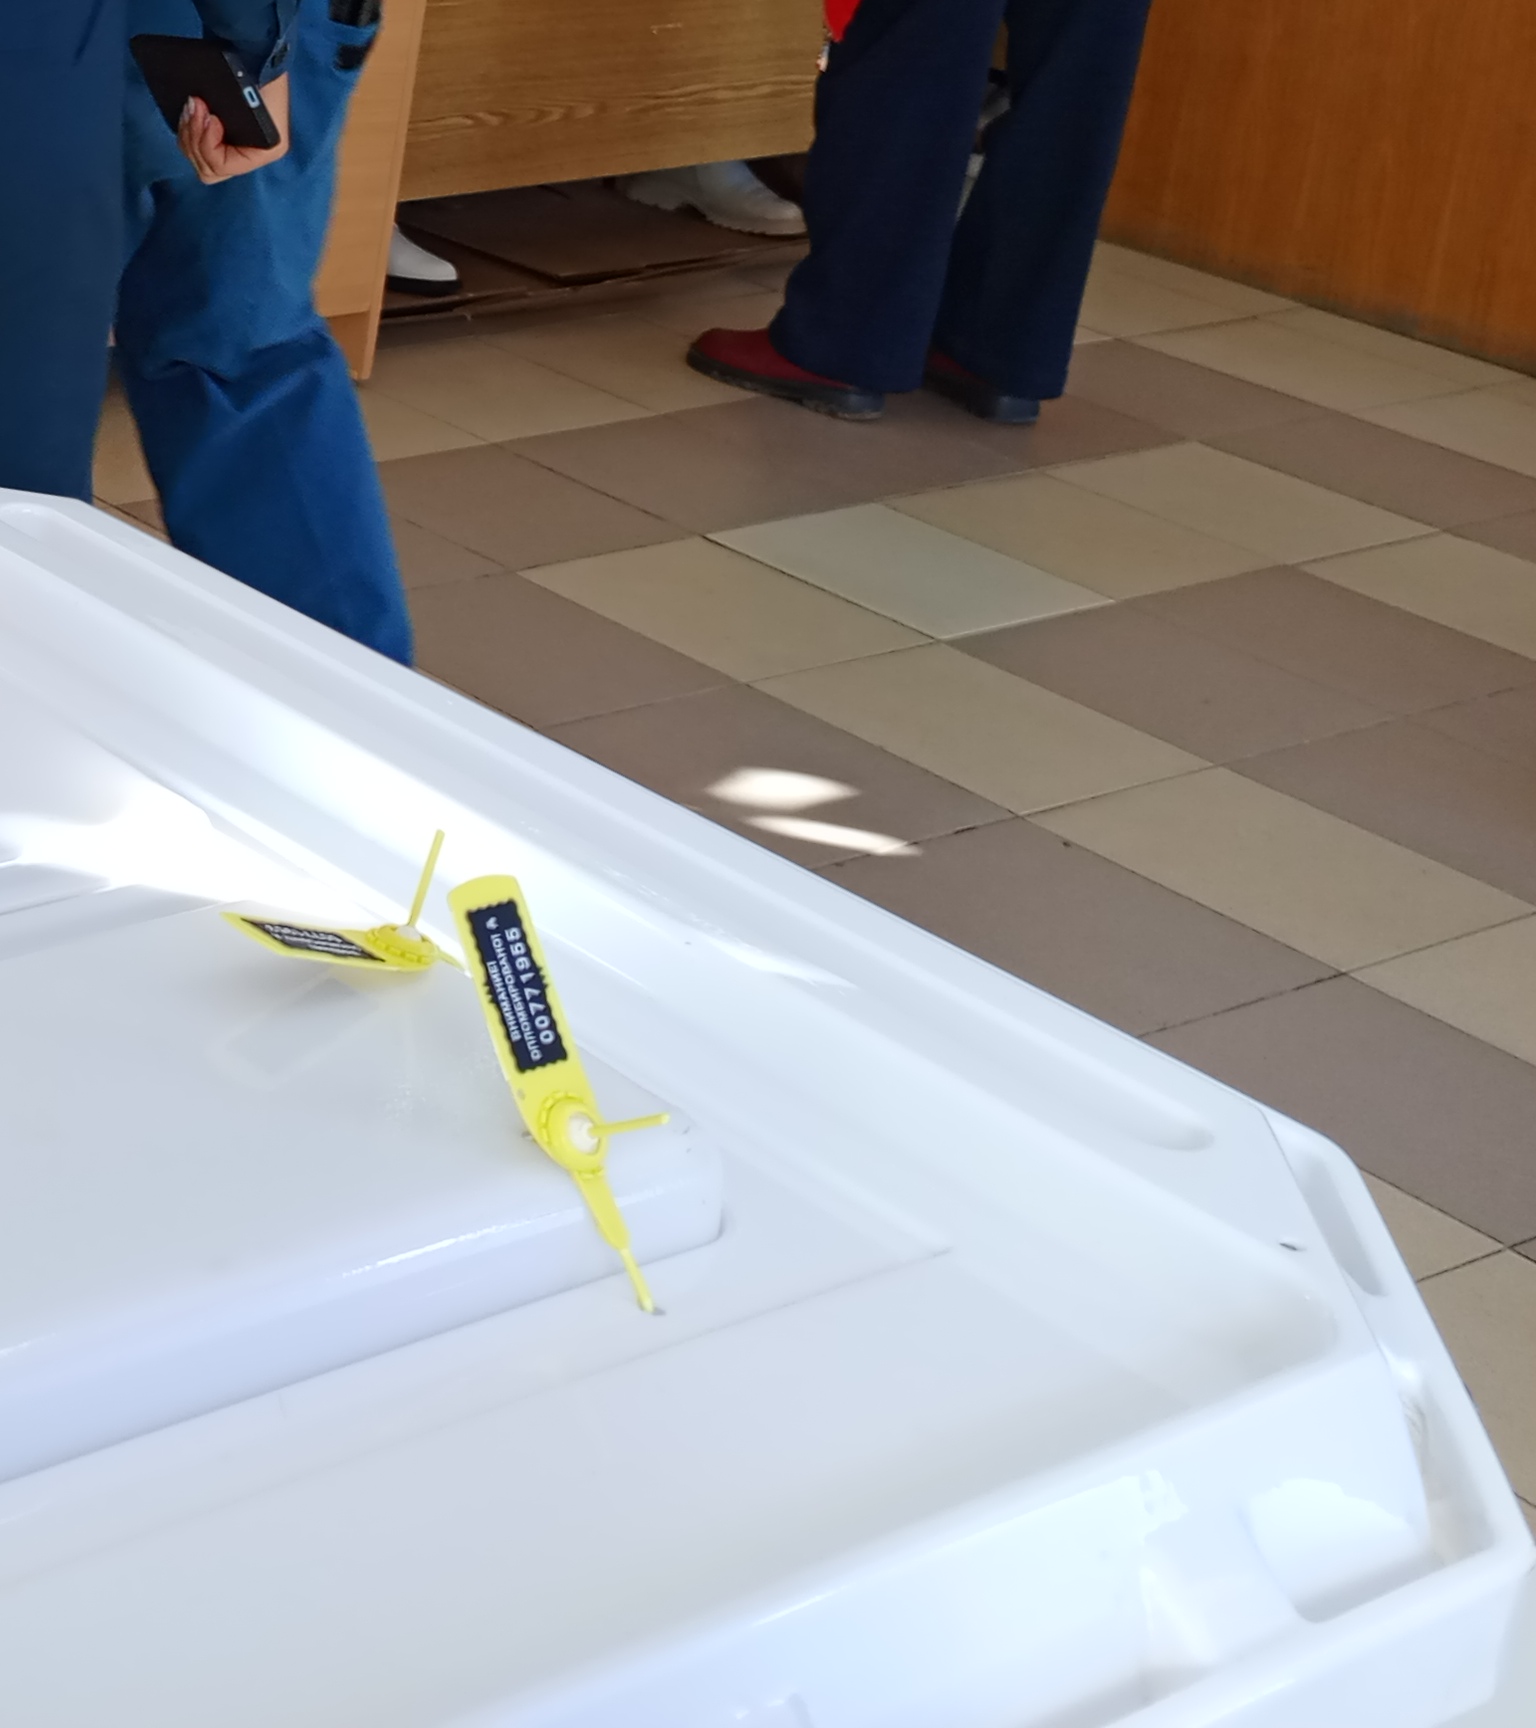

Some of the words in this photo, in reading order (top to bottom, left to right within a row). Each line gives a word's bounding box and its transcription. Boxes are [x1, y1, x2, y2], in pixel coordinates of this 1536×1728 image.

[485, 959, 521, 1042] ВНИМАНИЕ!
[489, 931, 542, 1062] ОПЛОМБИРОВАНО!
[503, 924, 556, 1046] 00771955
